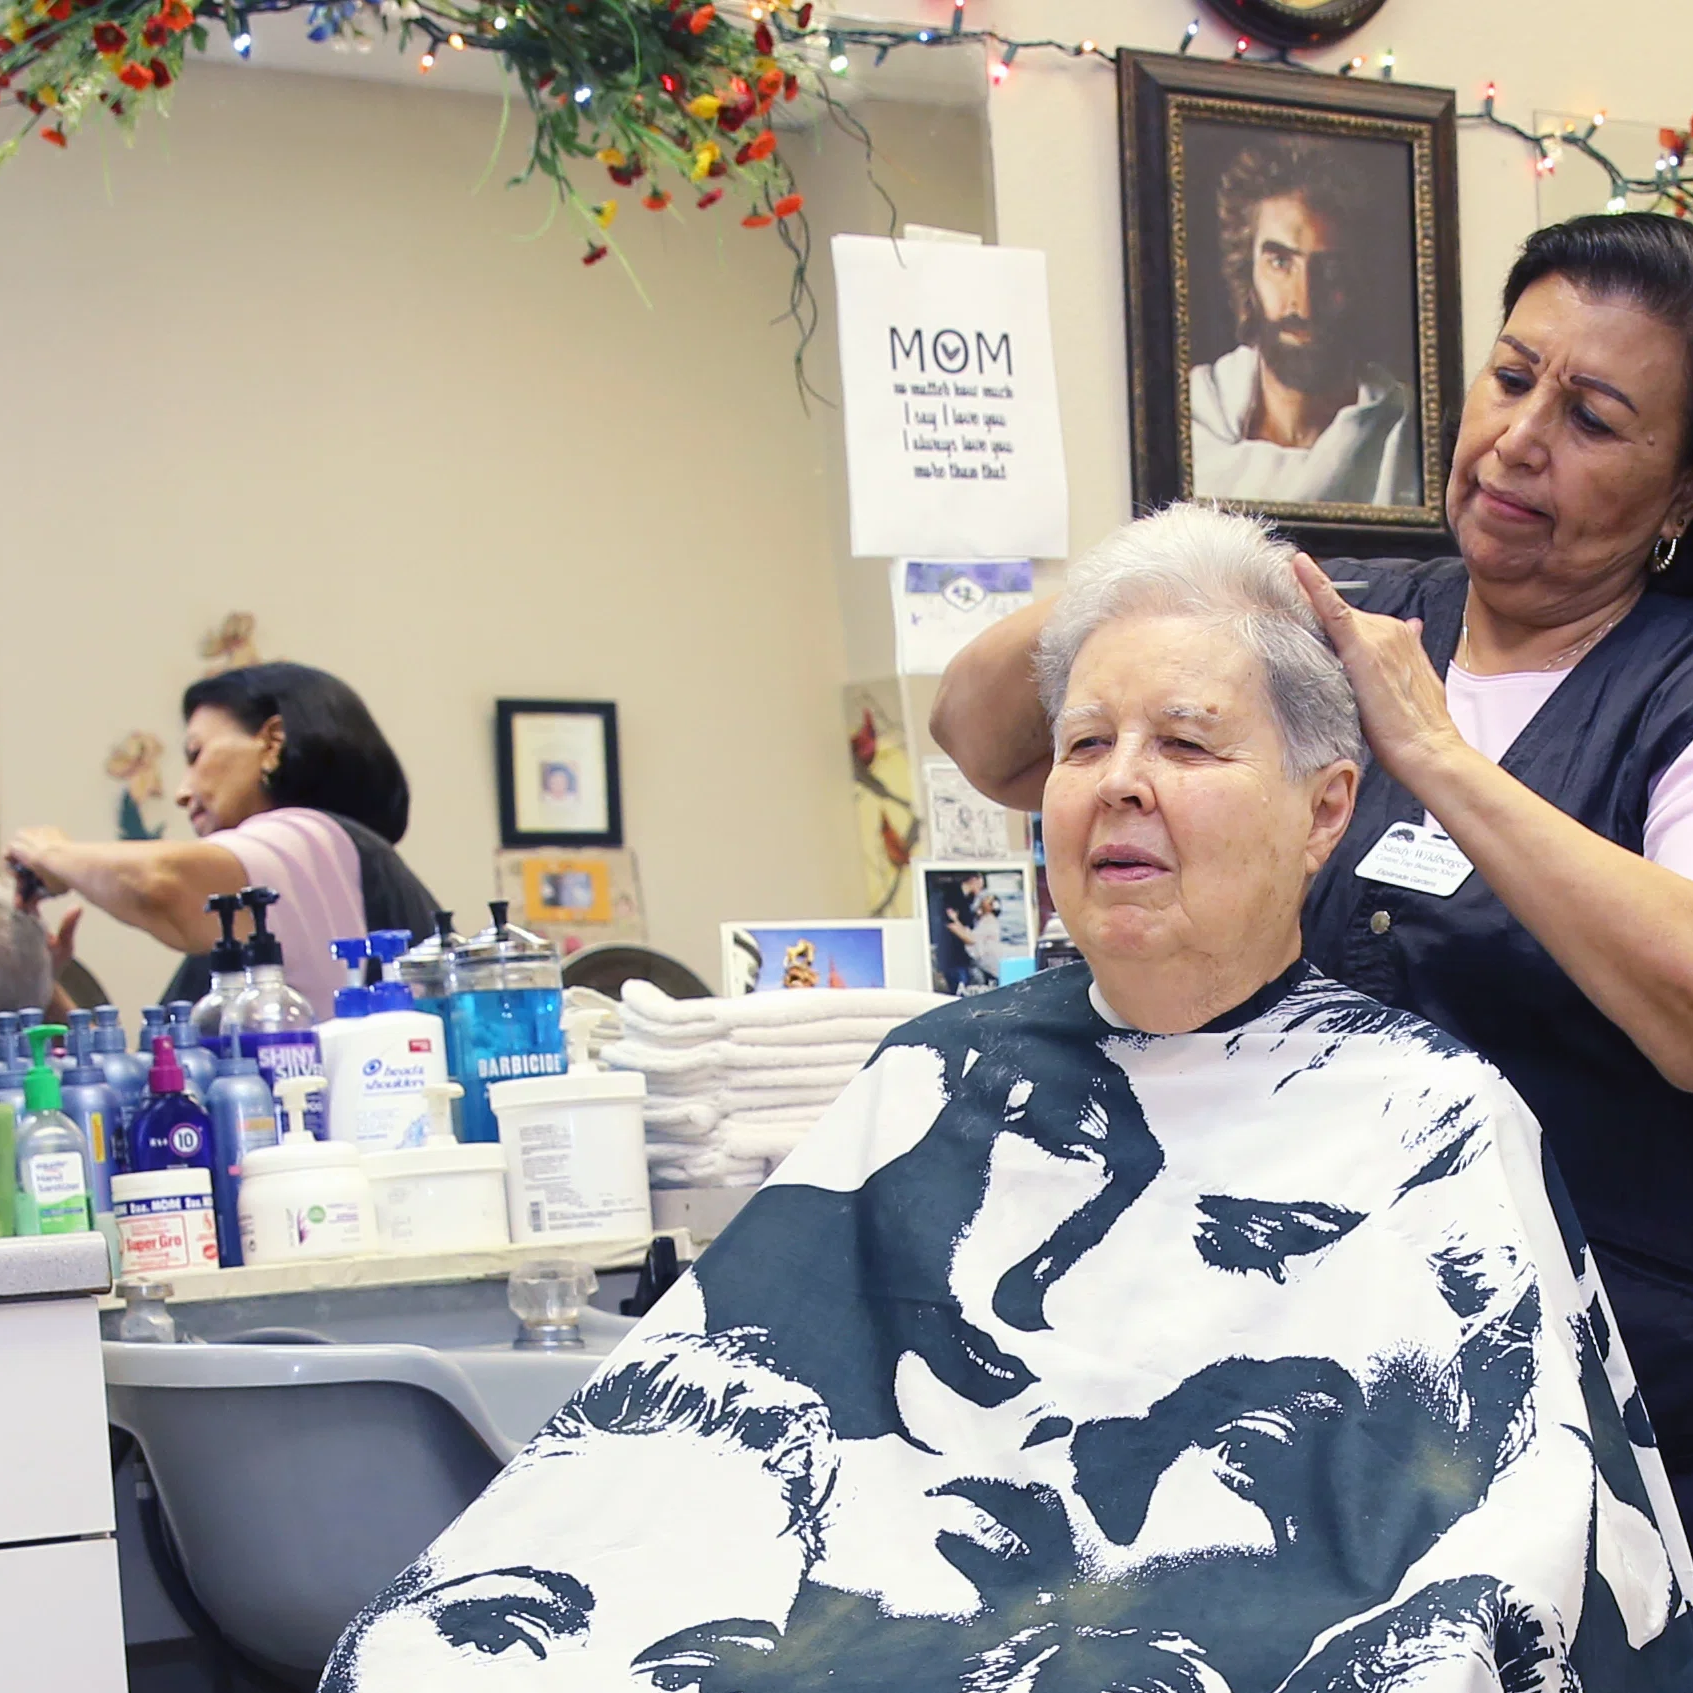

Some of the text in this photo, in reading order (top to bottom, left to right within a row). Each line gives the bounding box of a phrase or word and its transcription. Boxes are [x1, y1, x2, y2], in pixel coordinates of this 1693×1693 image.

[890, 326, 1012, 376] MOM
[257, 1046, 316, 1069] SHINY
[478, 1054, 563, 1078] BARBICIDE
[177, 1131, 195, 1150] 10
